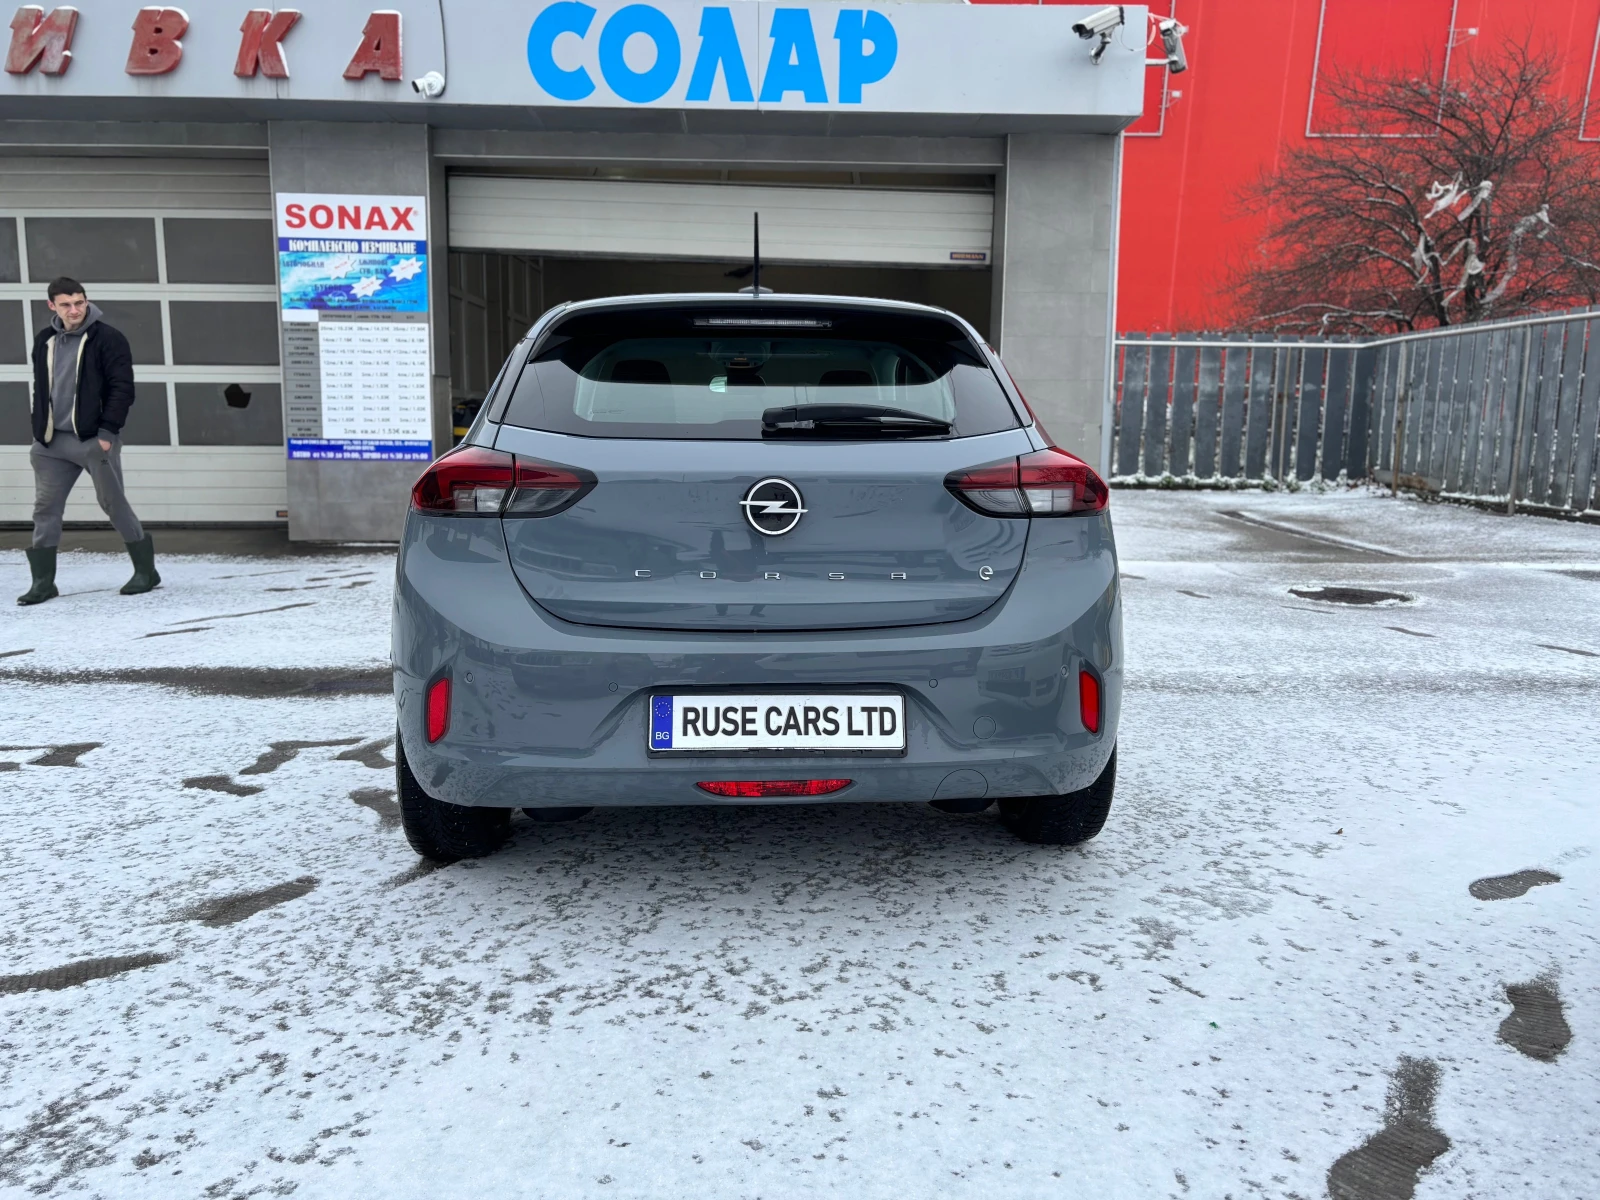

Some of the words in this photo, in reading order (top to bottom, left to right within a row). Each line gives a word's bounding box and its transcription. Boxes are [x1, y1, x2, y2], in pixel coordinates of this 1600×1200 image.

[527, 1, 898, 104] СОЛАР
[285, 204, 414, 231] SONAX
[289, 240, 359, 253] КОМПЛЕКСНО
[634, 569, 908, 580] CORSA
[682, 706, 758, 737] RUSE
[765, 706, 840, 736] CARS
[847, 706, 897, 736] LTD
[655, 731, 670, 741] BG
